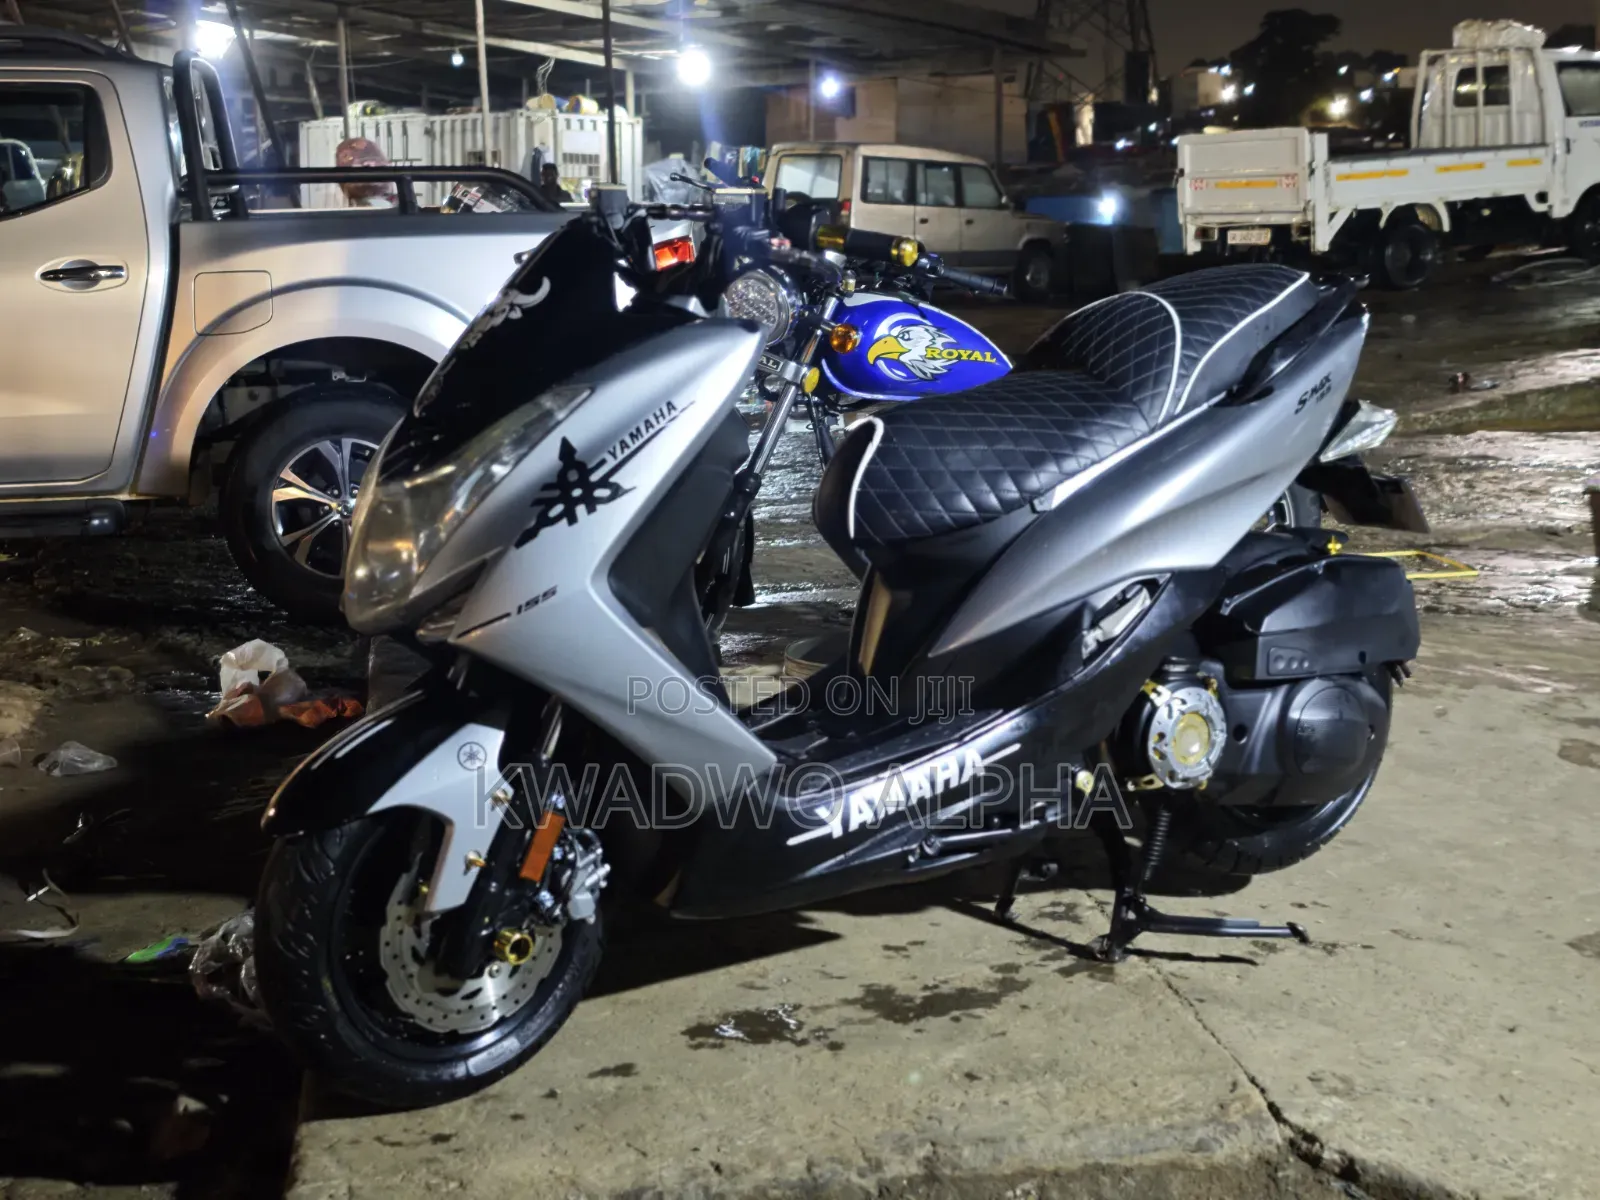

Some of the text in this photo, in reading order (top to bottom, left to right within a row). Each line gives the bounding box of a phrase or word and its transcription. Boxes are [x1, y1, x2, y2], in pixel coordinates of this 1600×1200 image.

[925, 347, 997, 363] ROYAL
[607, 400, 677, 461] YAMAHA
[815, 748, 985, 839] YAMAHA
